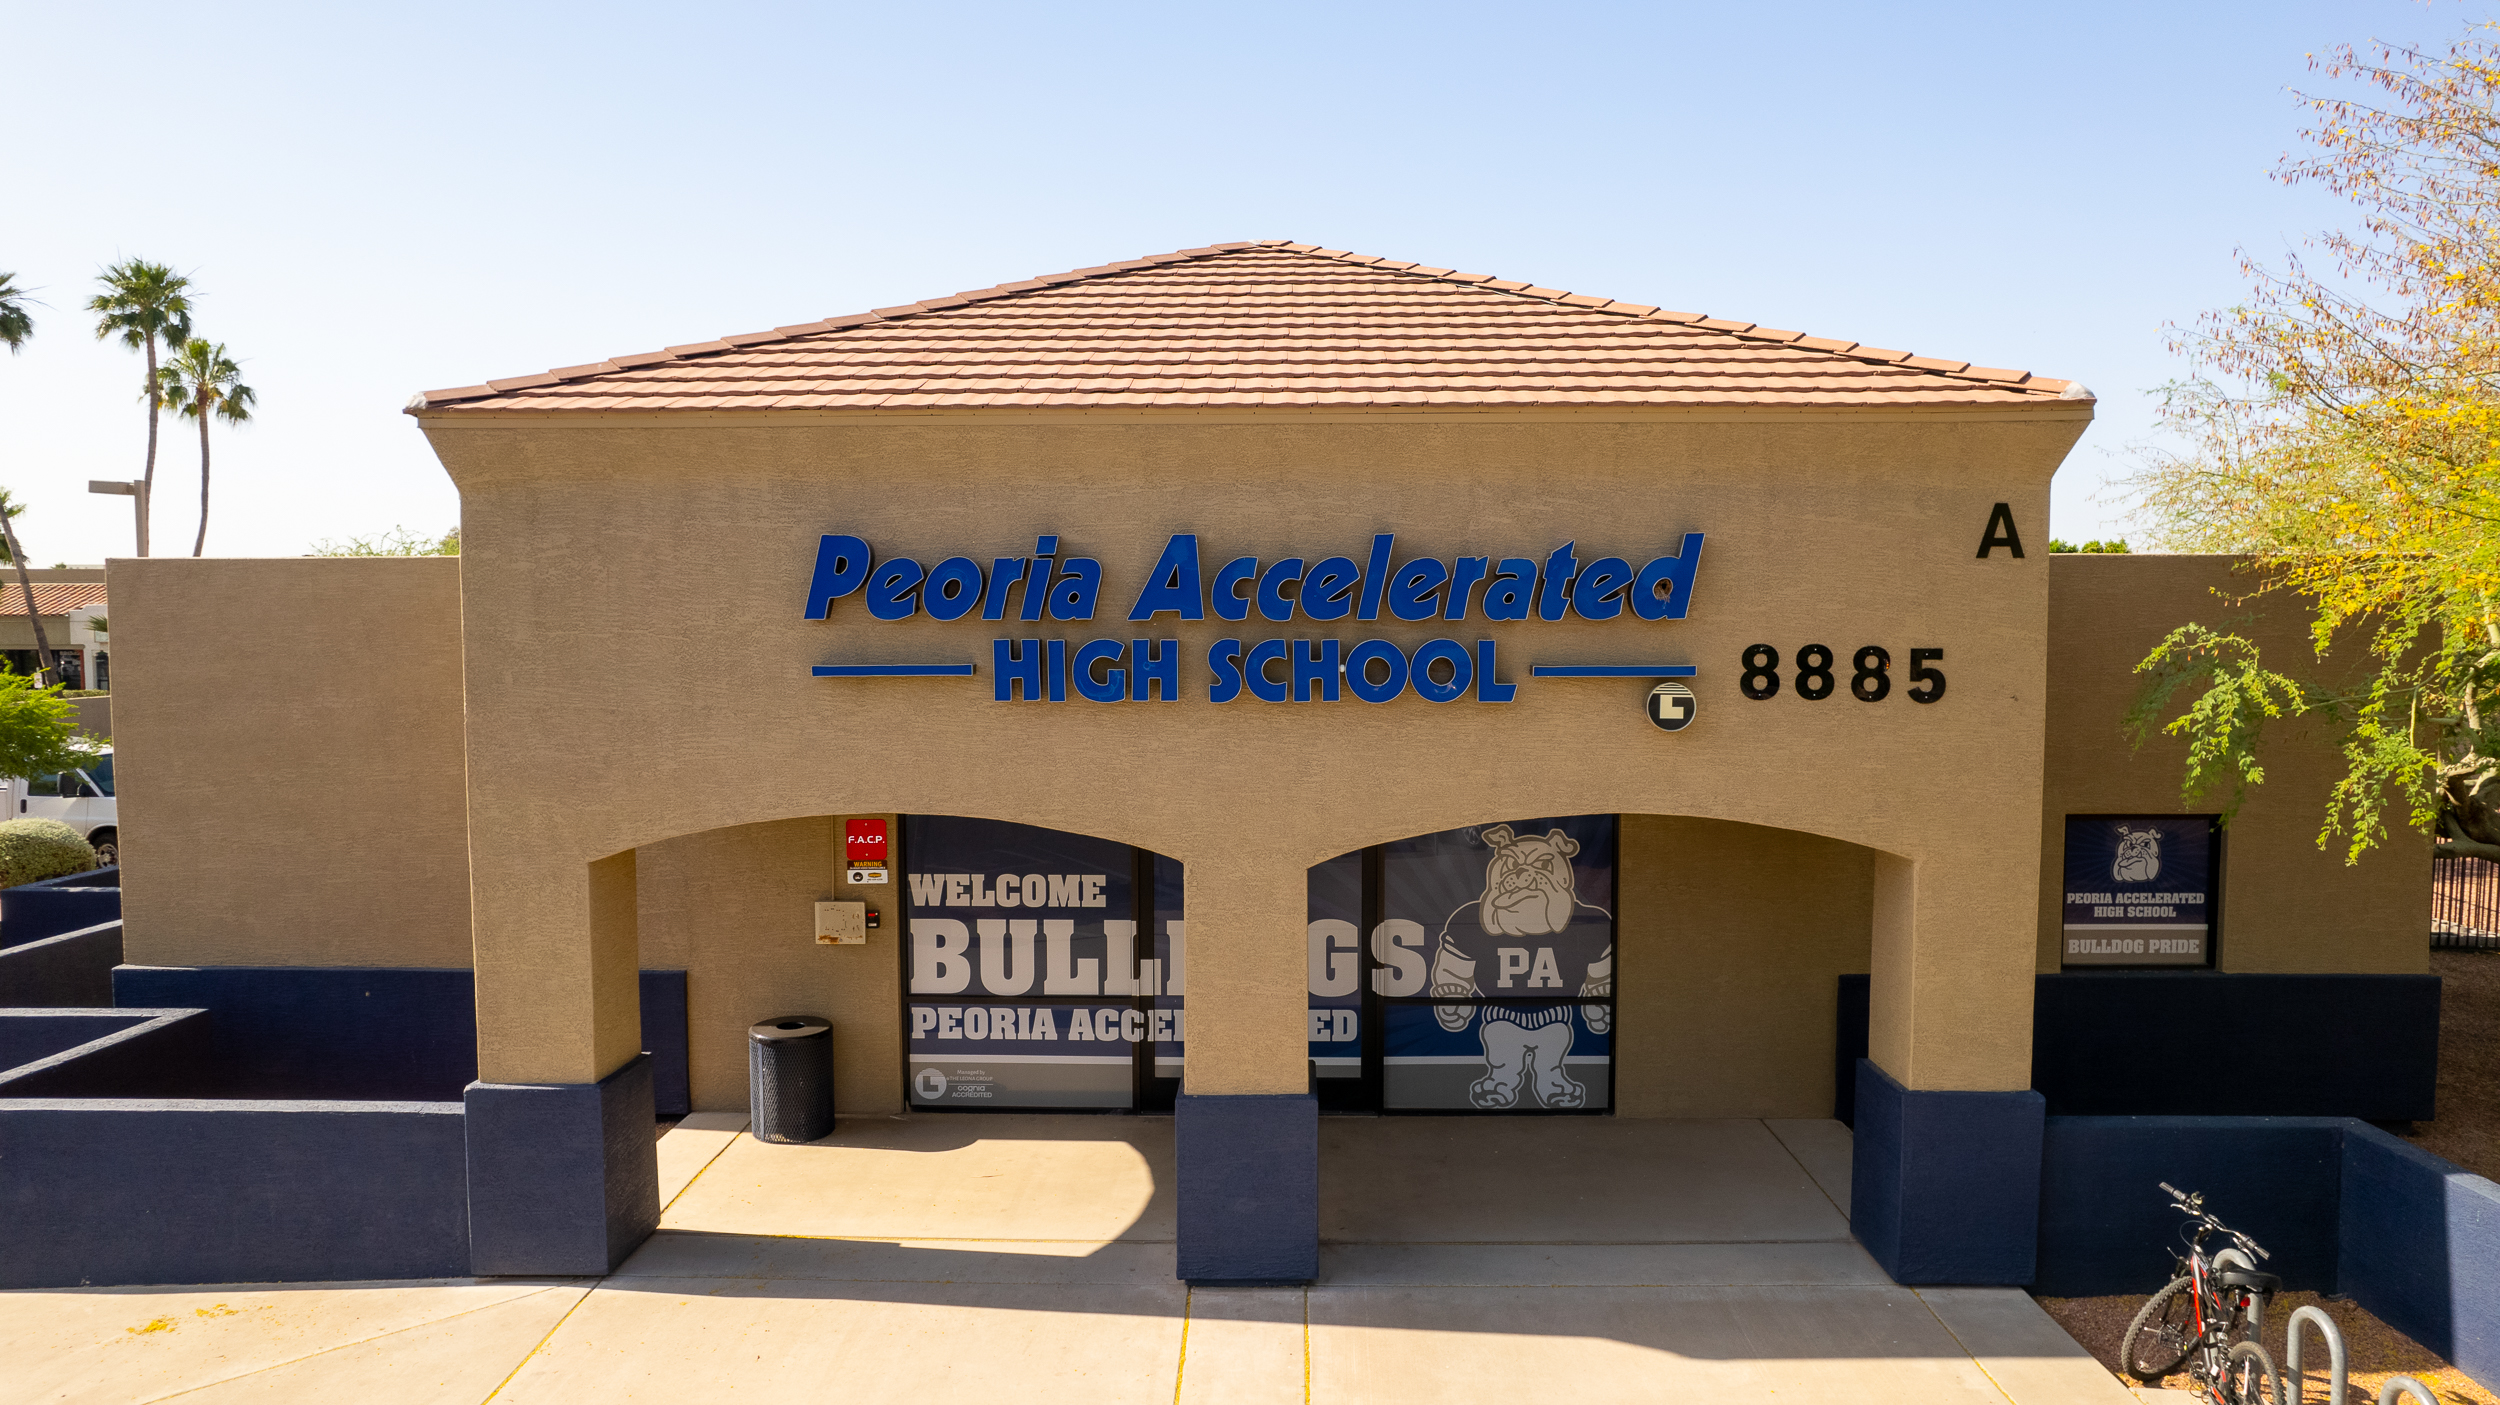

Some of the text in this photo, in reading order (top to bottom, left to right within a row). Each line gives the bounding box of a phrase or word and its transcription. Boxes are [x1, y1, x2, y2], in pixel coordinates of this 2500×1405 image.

[1976, 503, 2025, 559] A
[804, 532, 1706, 621] Peoria Accelerated
[993, 638, 1517, 704] HIGH SCHOOL
[1740, 643, 1947, 704] 8885
[848, 835, 885, 844] F.A.C.P.
[908, 874, 1107, 908] WELCOME
[2067, 893, 2204, 904] PEORIA ACCELERATED
[2094, 906, 2177, 918] HIGH SCHOOL
[910, 918, 1428, 997] BULLGS
[2068, 939, 2200, 954] BULLDOG PRIDE
[1497, 947, 1564, 989] PA
[911, 1007, 1058, 1041] PEORIA
